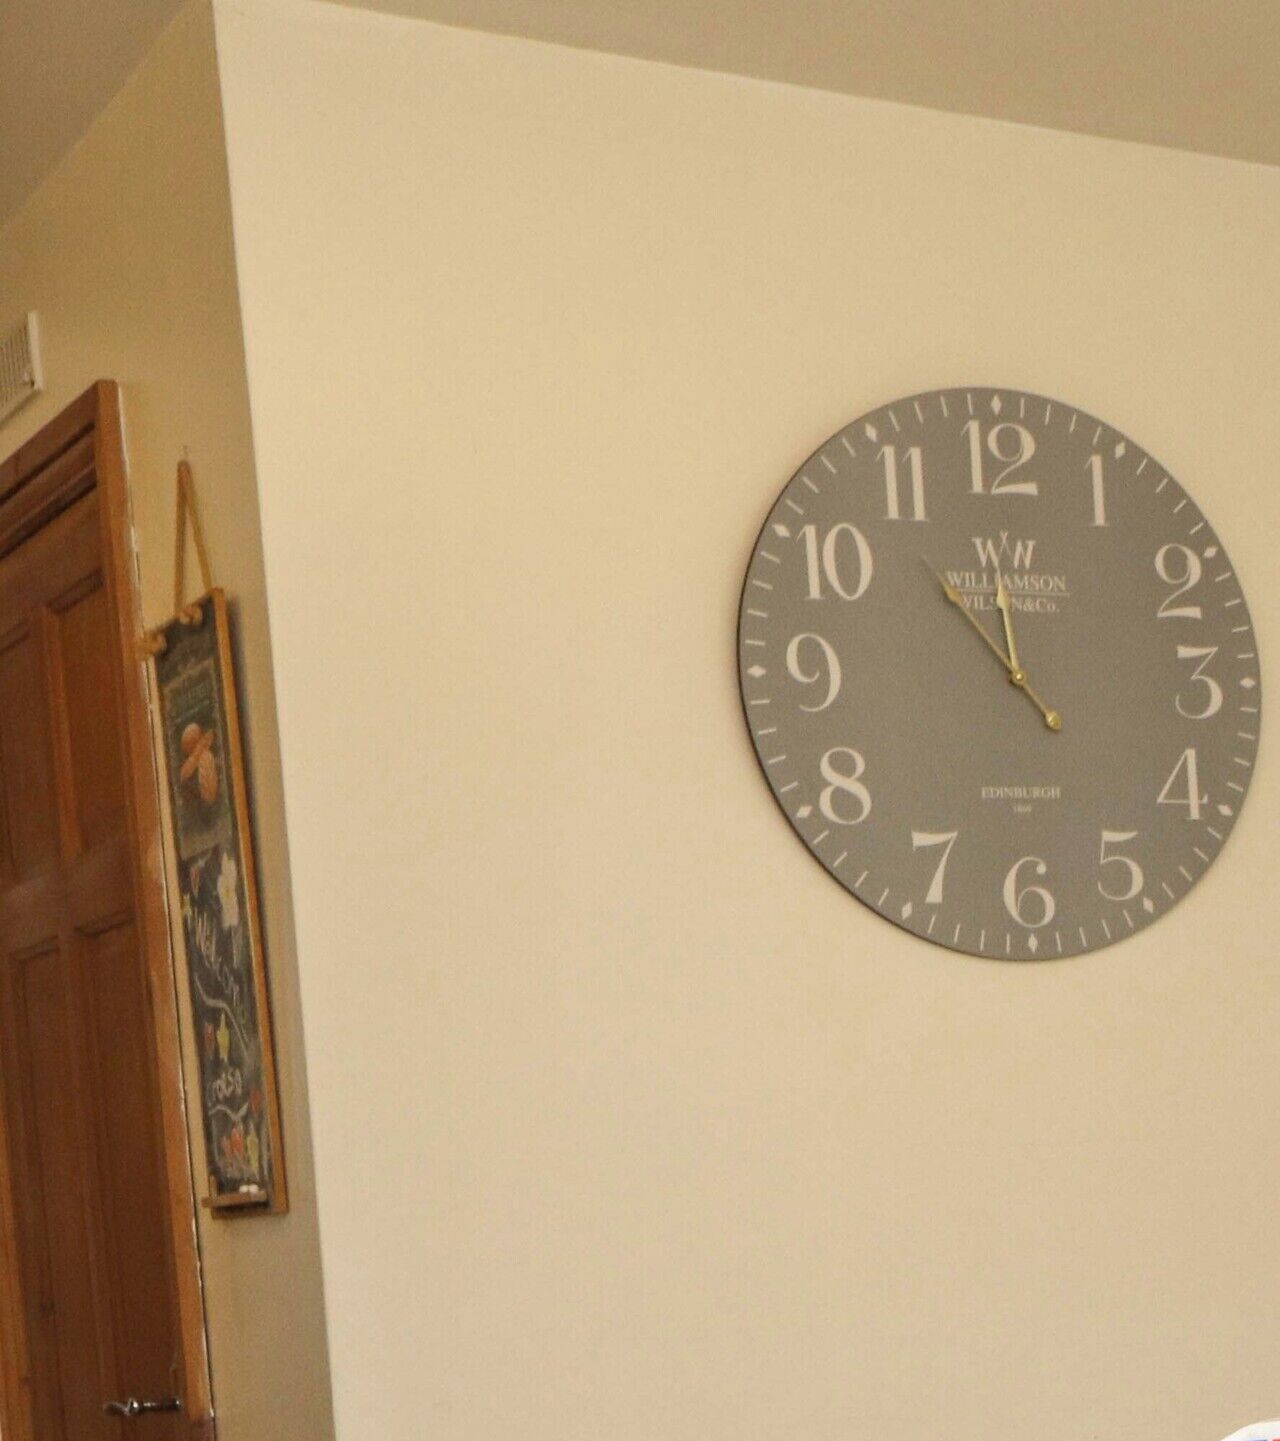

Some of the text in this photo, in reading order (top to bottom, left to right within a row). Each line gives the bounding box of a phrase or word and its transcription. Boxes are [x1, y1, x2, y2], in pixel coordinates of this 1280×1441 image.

[875, 444, 928, 522] 11
[963, 420, 1038, 496] 12
[1084, 452, 1107, 528] 1
[798, 523, 873, 602] 10
[1154, 543, 1203, 619] 2
[785, 632, 842, 713] 9
[1174, 645, 1224, 720] 3
[818, 746, 873, 825] 8
[981, 786, 1061, 799] EDINBURGH
[1155, 747, 1209, 822] 4
[910, 830, 959, 905] 7
[1002, 856, 1057, 928] 6
[1096, 829, 1147, 902] 5
